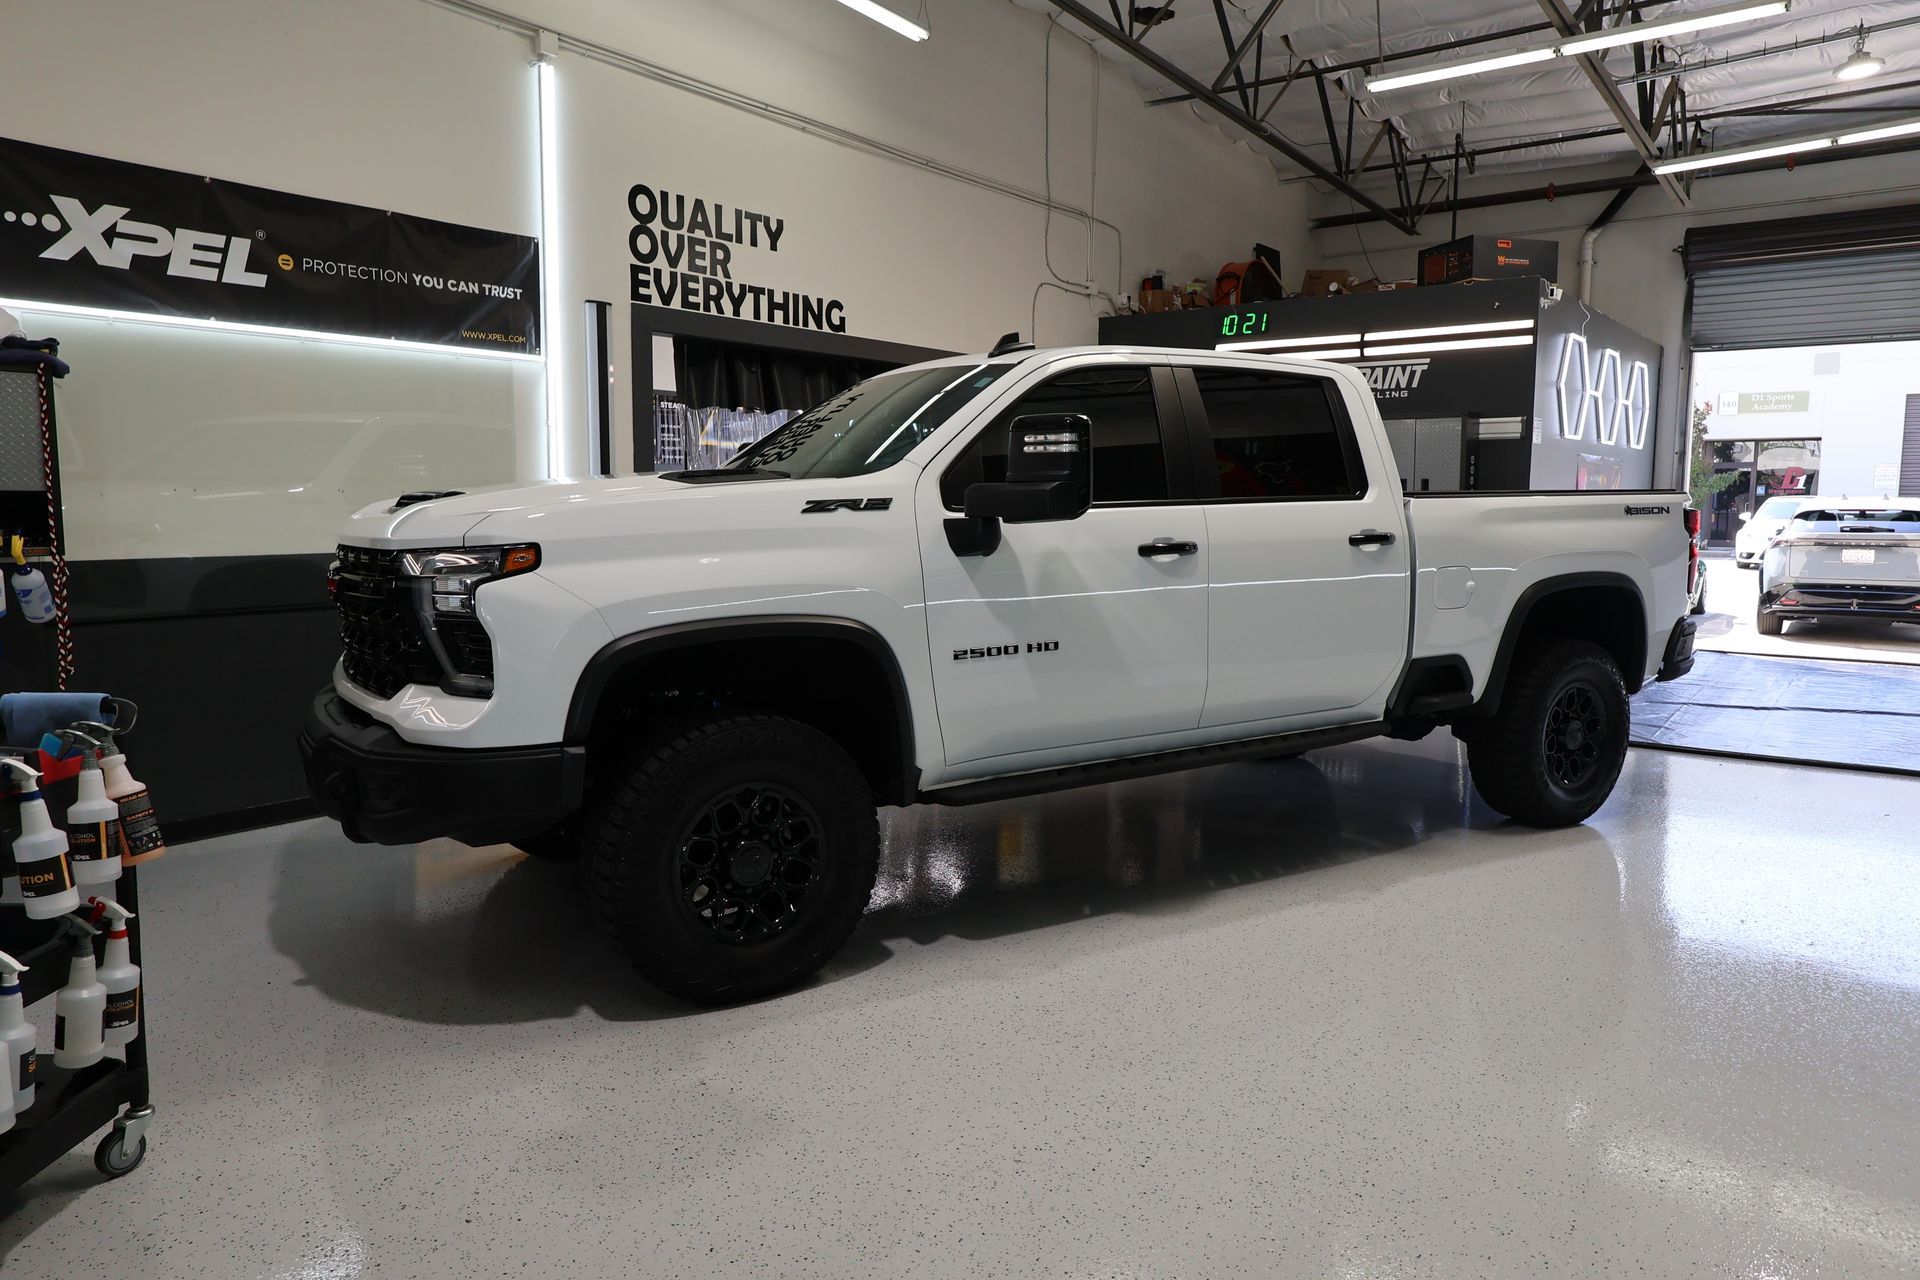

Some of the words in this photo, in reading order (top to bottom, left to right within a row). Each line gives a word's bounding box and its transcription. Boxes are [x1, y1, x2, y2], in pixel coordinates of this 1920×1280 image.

[627, 183, 784, 252] QUALITY
[38, 194, 268, 288] XPEL
[628, 223, 732, 280] OVER
[302, 257, 408, 285] PROTECTION
[412, 273, 444, 290] YOU
[447, 279, 479, 295] CAN
[482, 283, 523, 300] TRUST
[629, 263, 847, 334] EVERYTHING
[461, 329, 526, 343] WWW.XPEL.COM
[1751, 402, 1793, 412] Academy
[1766, 393, 1795, 403] Sports
[801, 497, 893, 514] ZR2
[1629, 506, 1670, 515] BISON
[953, 644, 1019, 660] 2500
[1026, 640, 1059, 653] HD
